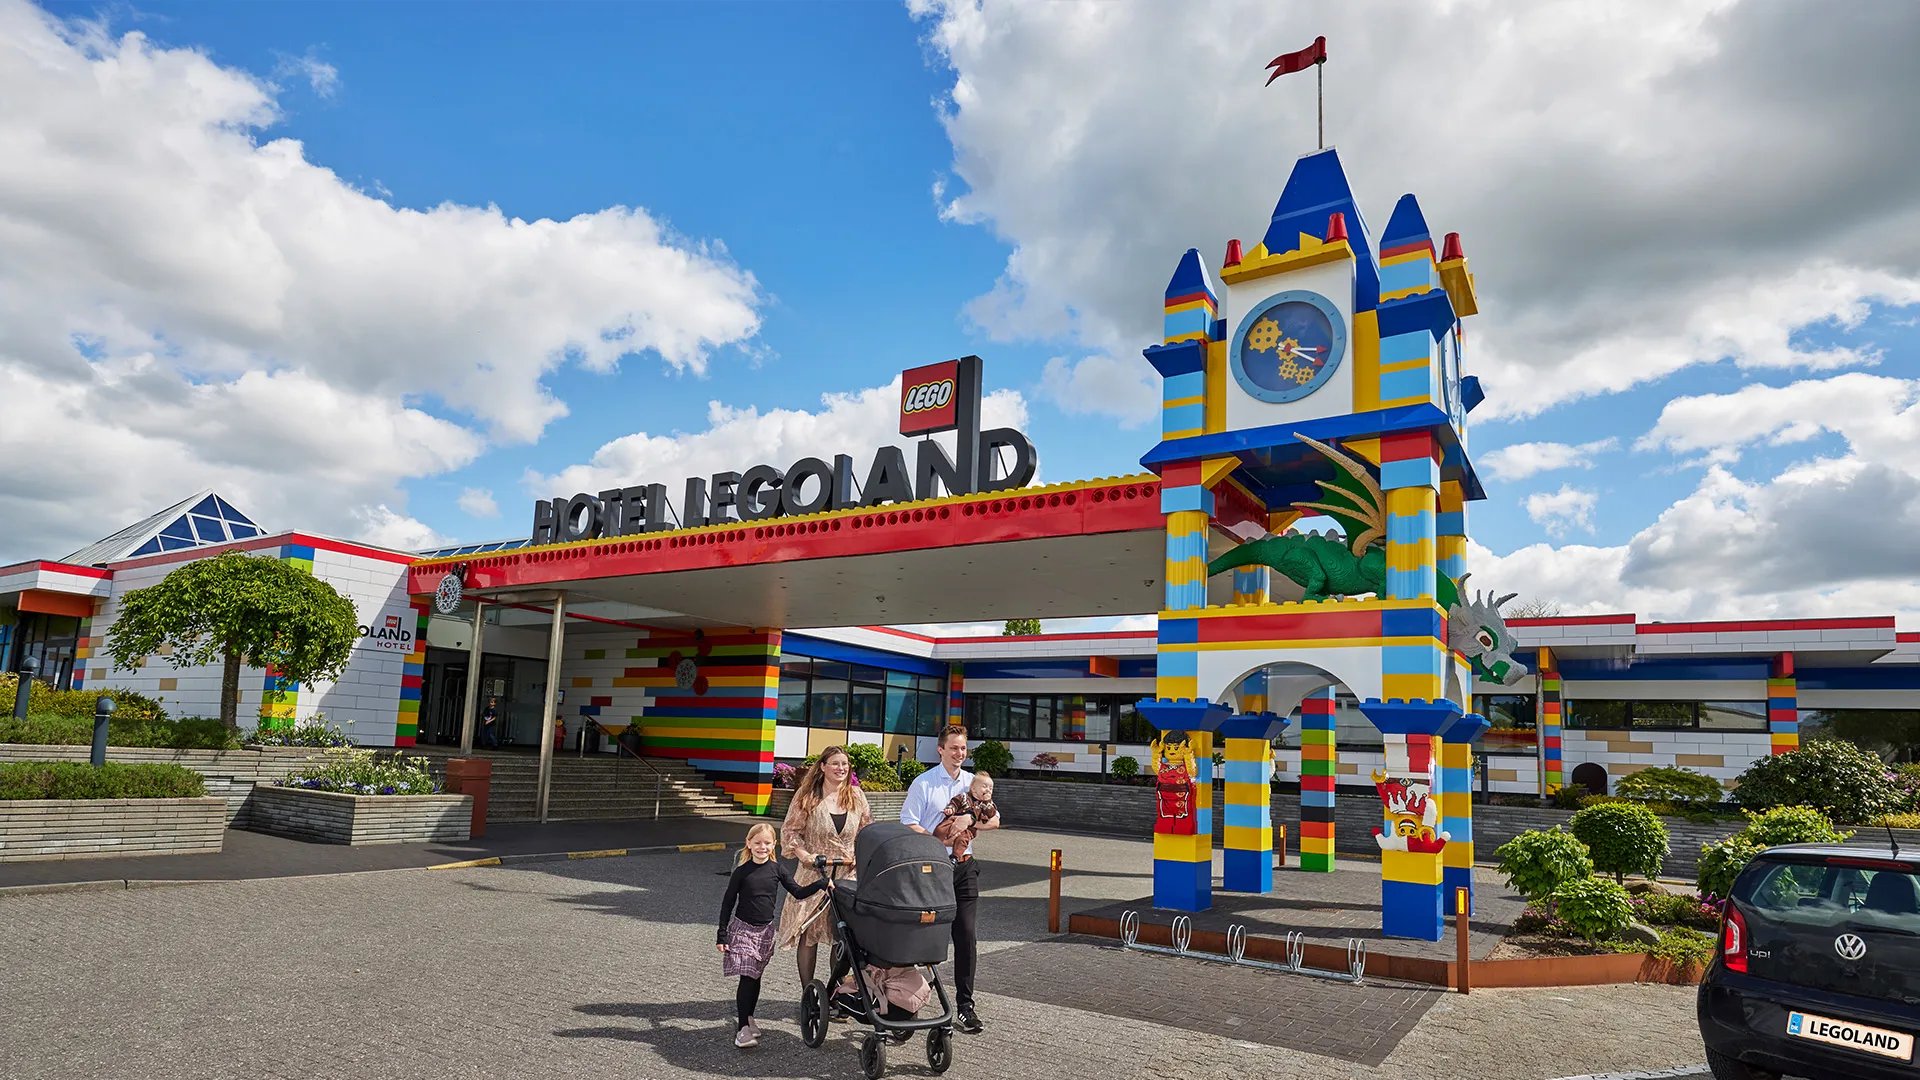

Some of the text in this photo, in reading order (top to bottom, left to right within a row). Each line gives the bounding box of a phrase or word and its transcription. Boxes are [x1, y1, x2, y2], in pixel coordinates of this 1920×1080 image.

[903, 379, 954, 414] LEGO
[532, 355, 1037, 546] HOTEL LEGOLAND
[358, 617, 411, 642] OLAND
[376, 641, 411, 651] HOTEL
[1750, 949, 1771, 959] up!
[1809, 1020, 1900, 1051] LEGOLAND
